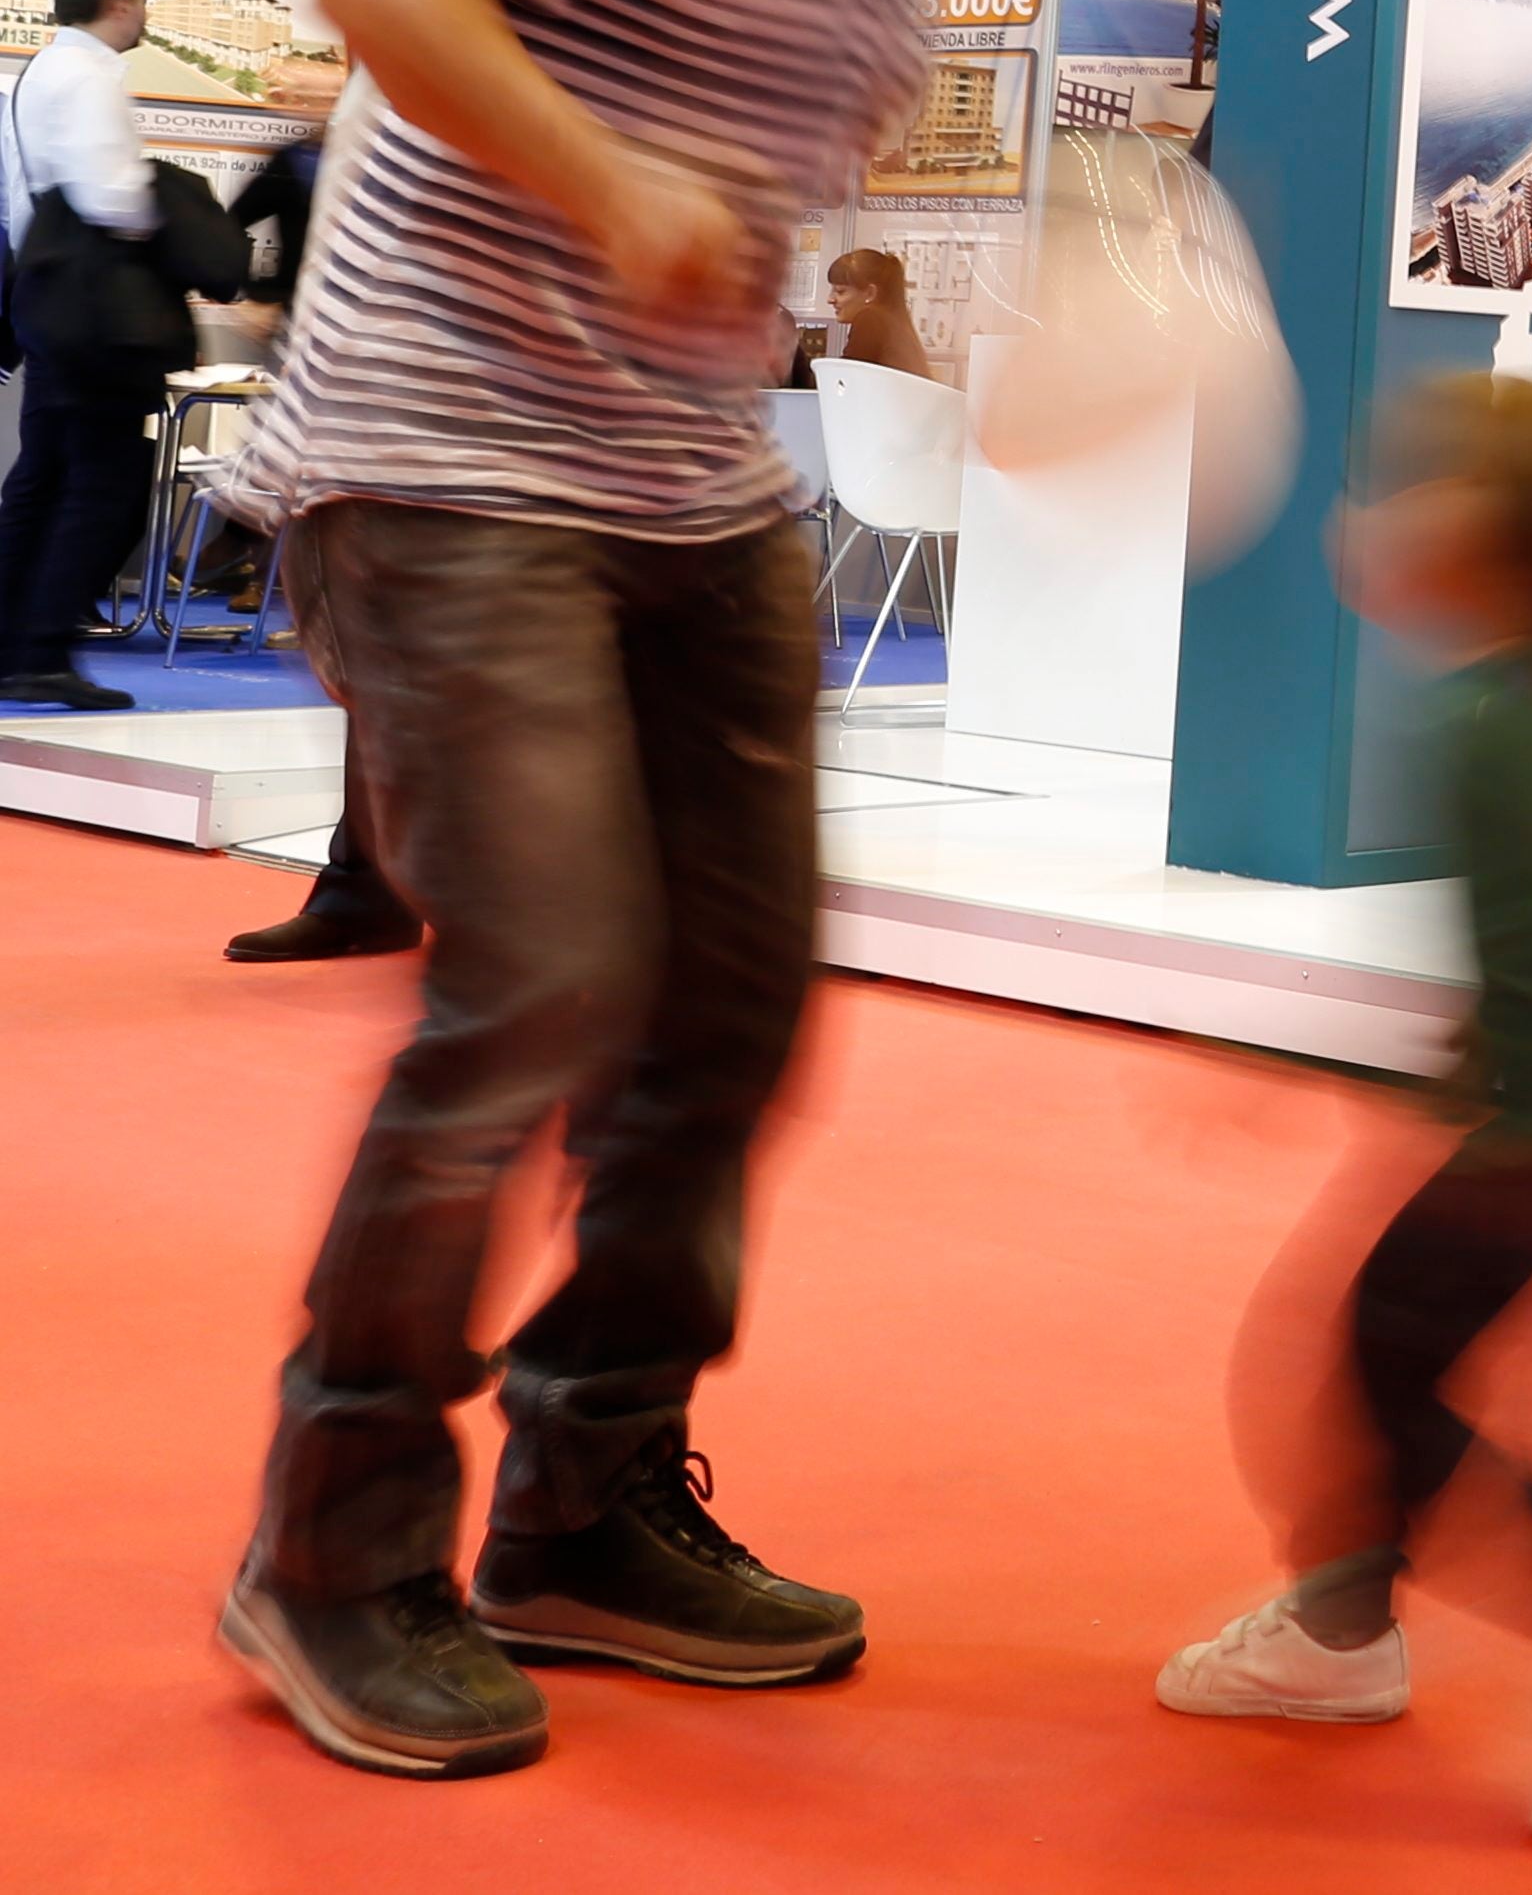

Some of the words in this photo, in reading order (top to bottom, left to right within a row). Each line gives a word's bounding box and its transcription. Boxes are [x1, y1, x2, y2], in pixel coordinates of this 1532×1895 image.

[968, 31, 1006, 47] LIBRE
[135, 112, 147, 124] 3
[155, 114, 322, 138] DORMITORIOS
[231, 159, 246, 172] de
